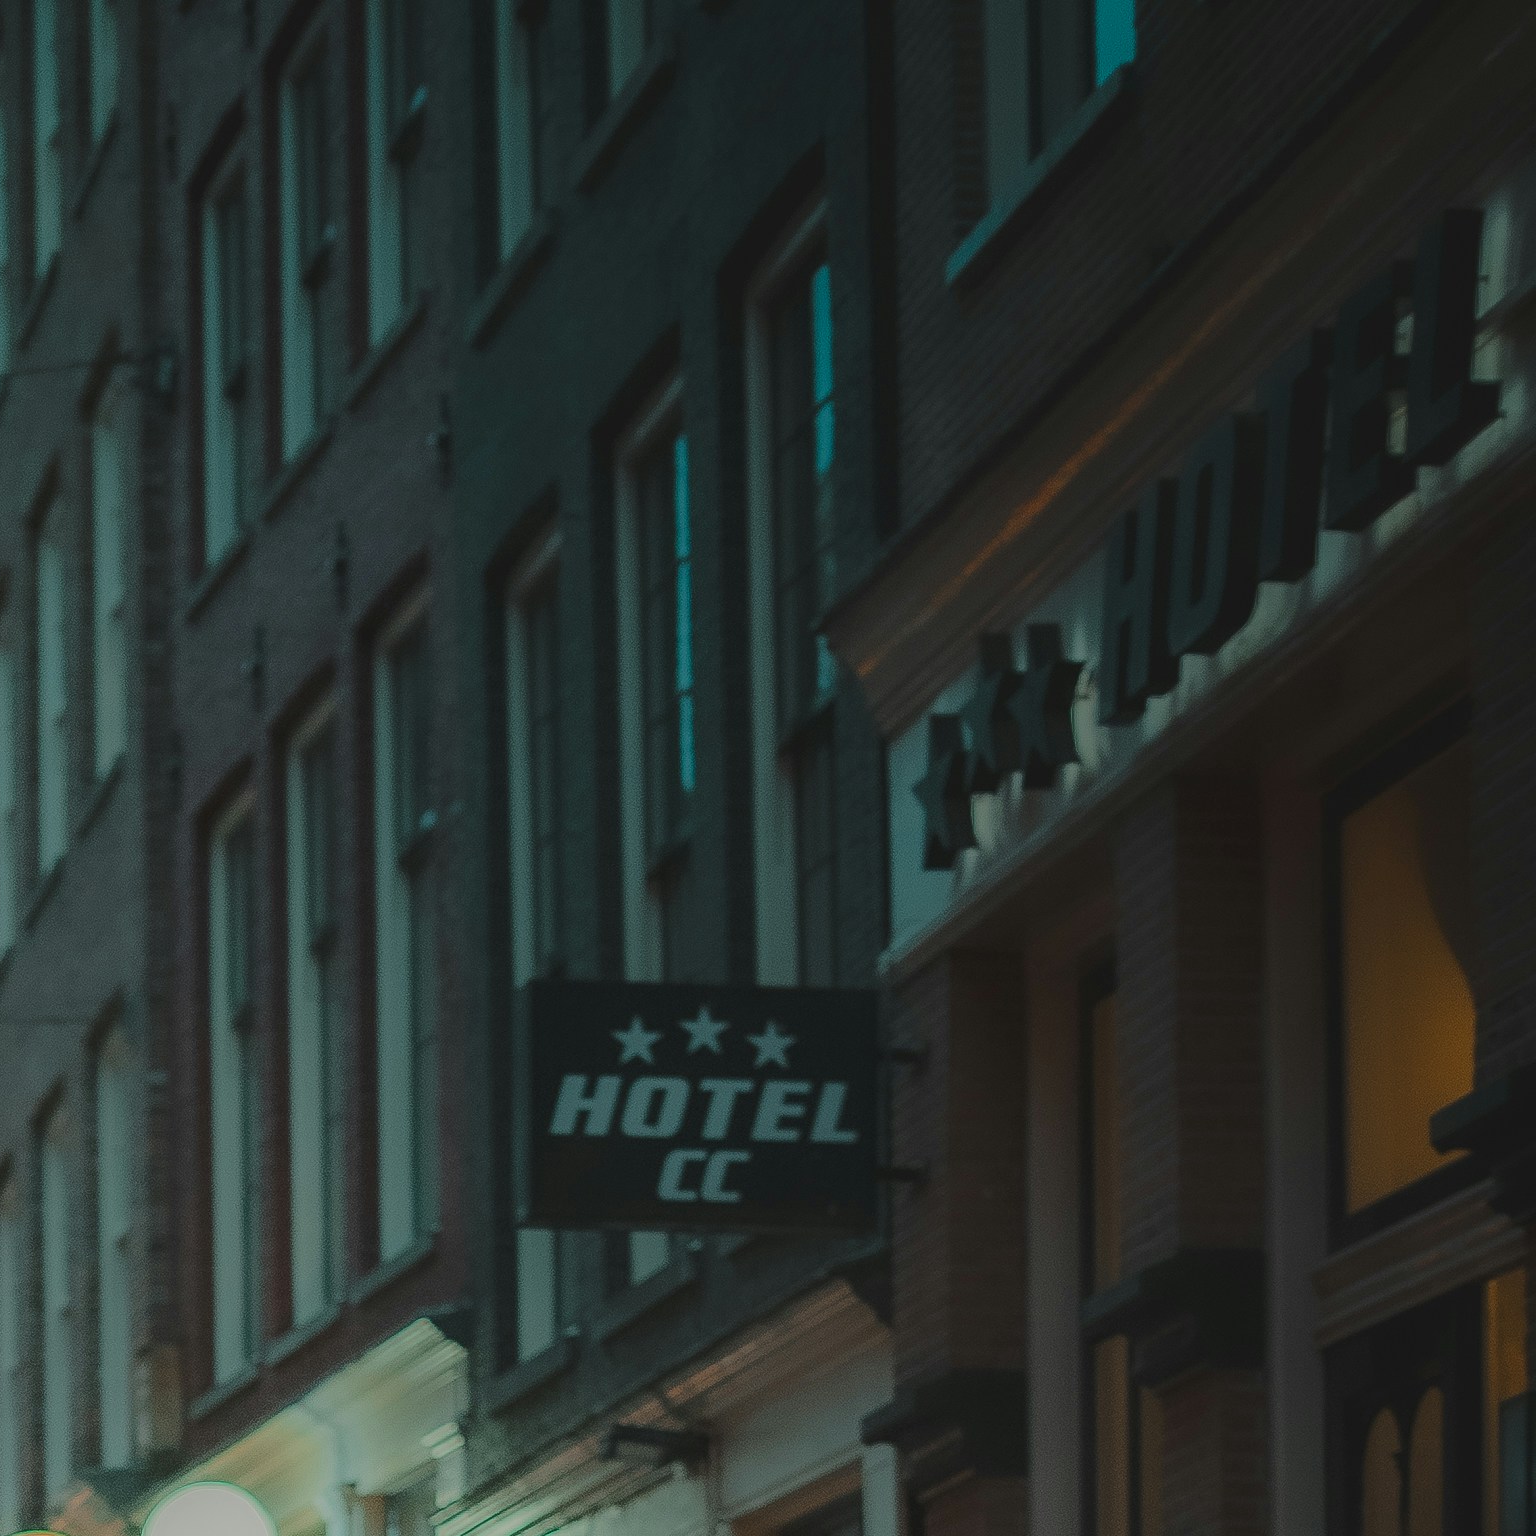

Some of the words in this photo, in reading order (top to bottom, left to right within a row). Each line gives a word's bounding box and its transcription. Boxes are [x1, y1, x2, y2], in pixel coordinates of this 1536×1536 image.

[1100, 209, 1501, 727] HOTEL
[550, 1074, 859, 1144] HOTEL
[656, 1148, 752, 1204] CC
